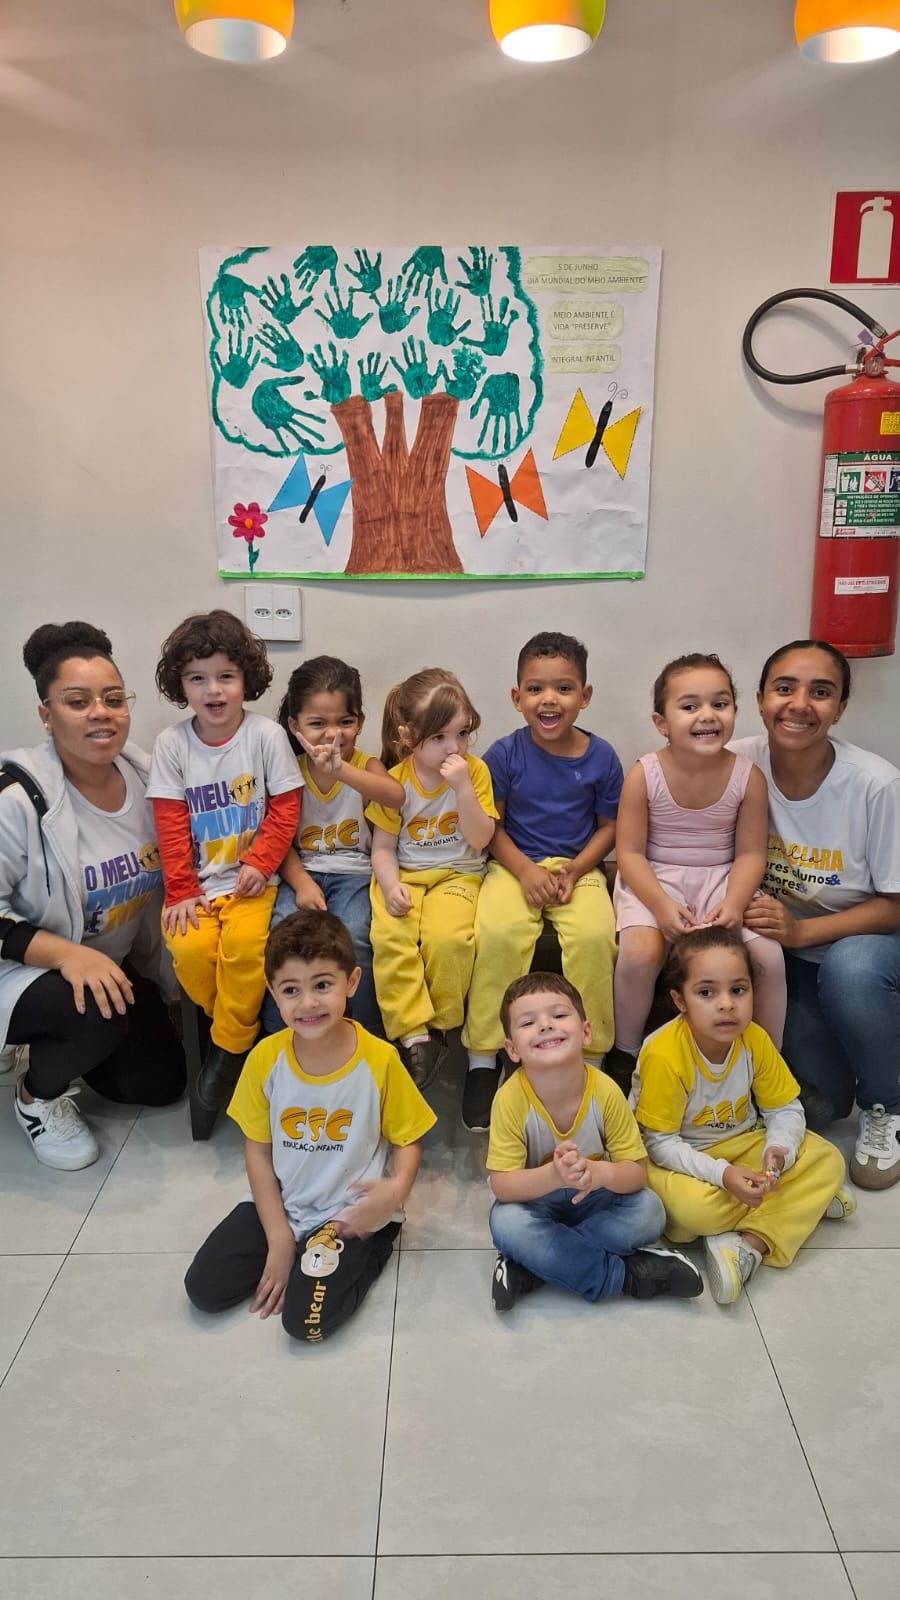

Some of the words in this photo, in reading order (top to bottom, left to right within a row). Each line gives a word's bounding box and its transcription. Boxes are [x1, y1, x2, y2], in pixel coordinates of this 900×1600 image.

[558, 263, 562, 271] 5
[563, 263, 573, 271] DE
[574, 263, 599, 271] JUNHO
[527, 277, 539, 285] DIA
[541, 276, 573, 284] MUNDIAL
[574, 276, 586, 284] DO
[587, 276, 606, 284] MEIO
[553, 311, 572, 319] MEIO
[573, 311, 609, 319] AMBIENTE
[553, 322, 570, 330] VIDA
[584, 354, 616, 362] INFANTIL
[864, 453, 892, 461] ÁGUA
[186, 781, 230, 813] MEU
[191, 802, 258, 843] MUNDO
[84, 865, 98, 891] O
[100, 851, 141, 889] MEU
[279, 1106, 354, 1142] CSC
[315, 1143, 344, 1153] INFANTIL
[304, 1279, 328, 1325] bear
